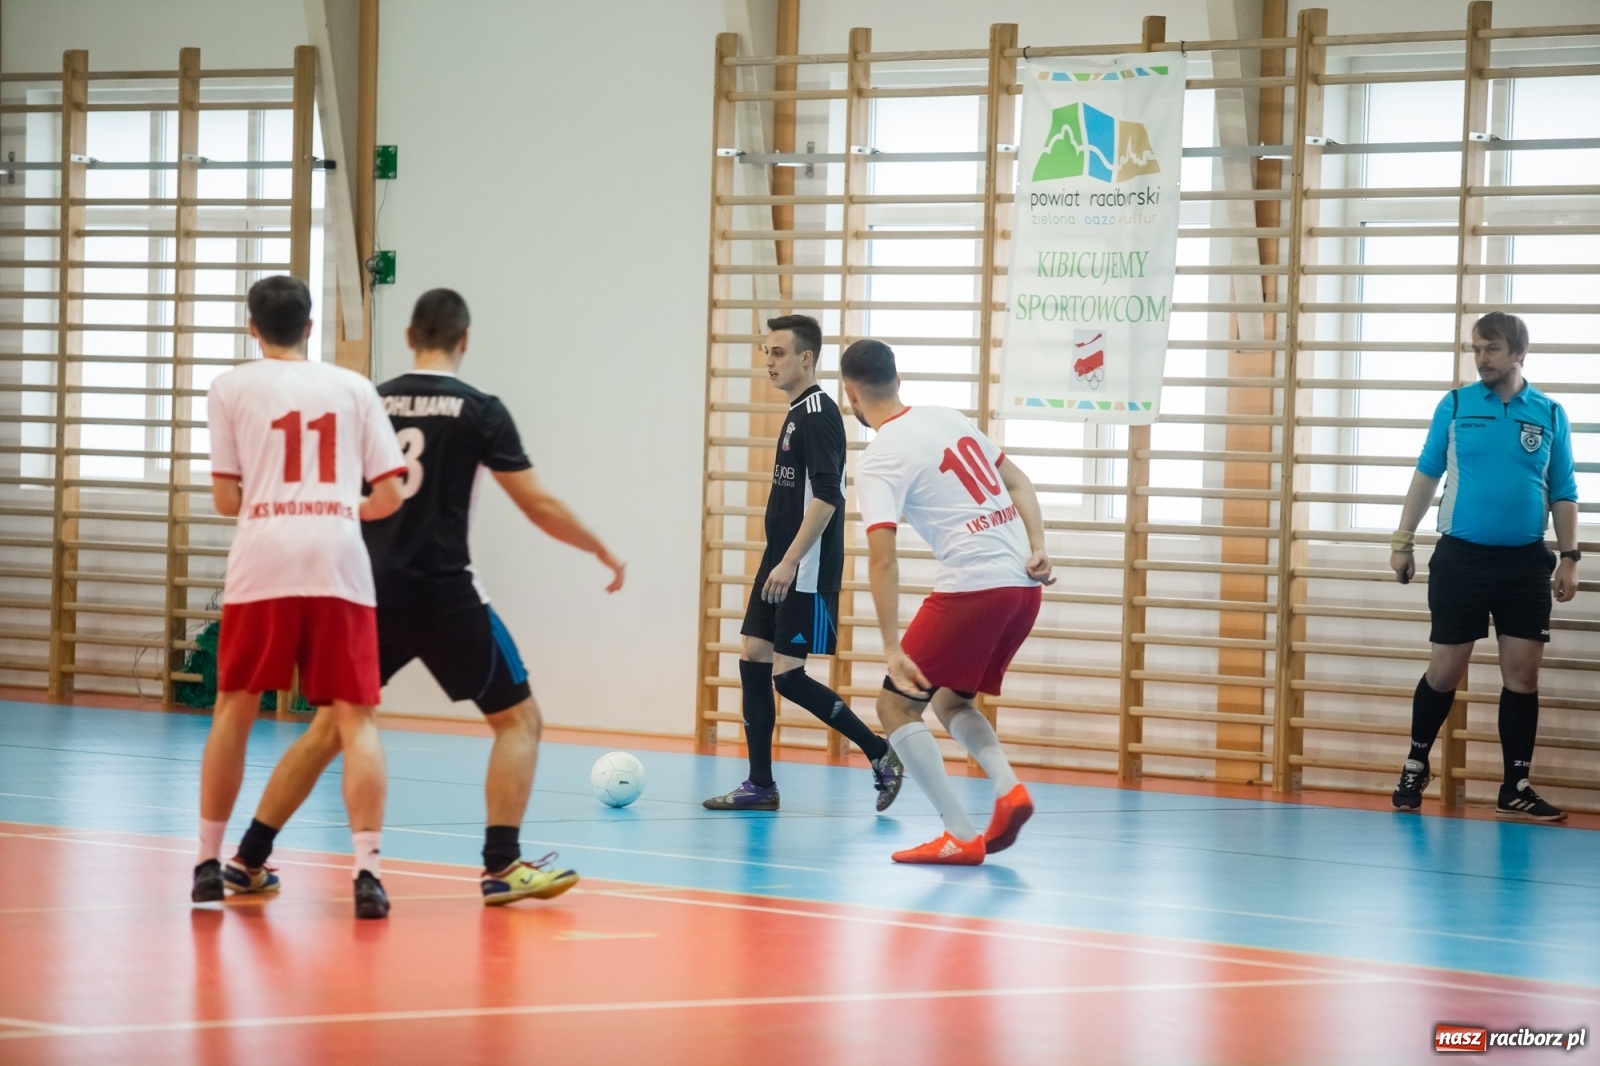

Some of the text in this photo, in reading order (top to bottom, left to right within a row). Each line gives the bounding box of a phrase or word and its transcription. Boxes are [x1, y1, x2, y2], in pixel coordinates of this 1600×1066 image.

[1030, 185, 1160, 211] powiat racibrski
[1031, 212, 1076, 225] zielona
[1036, 250, 1150, 285] KIBICUJEMY
[1015, 293, 1167, 323] SPORTOWCOM
[271, 410, 337, 484] 11
[938, 435, 1002, 506] 10
[966, 515, 990, 534] LKS
